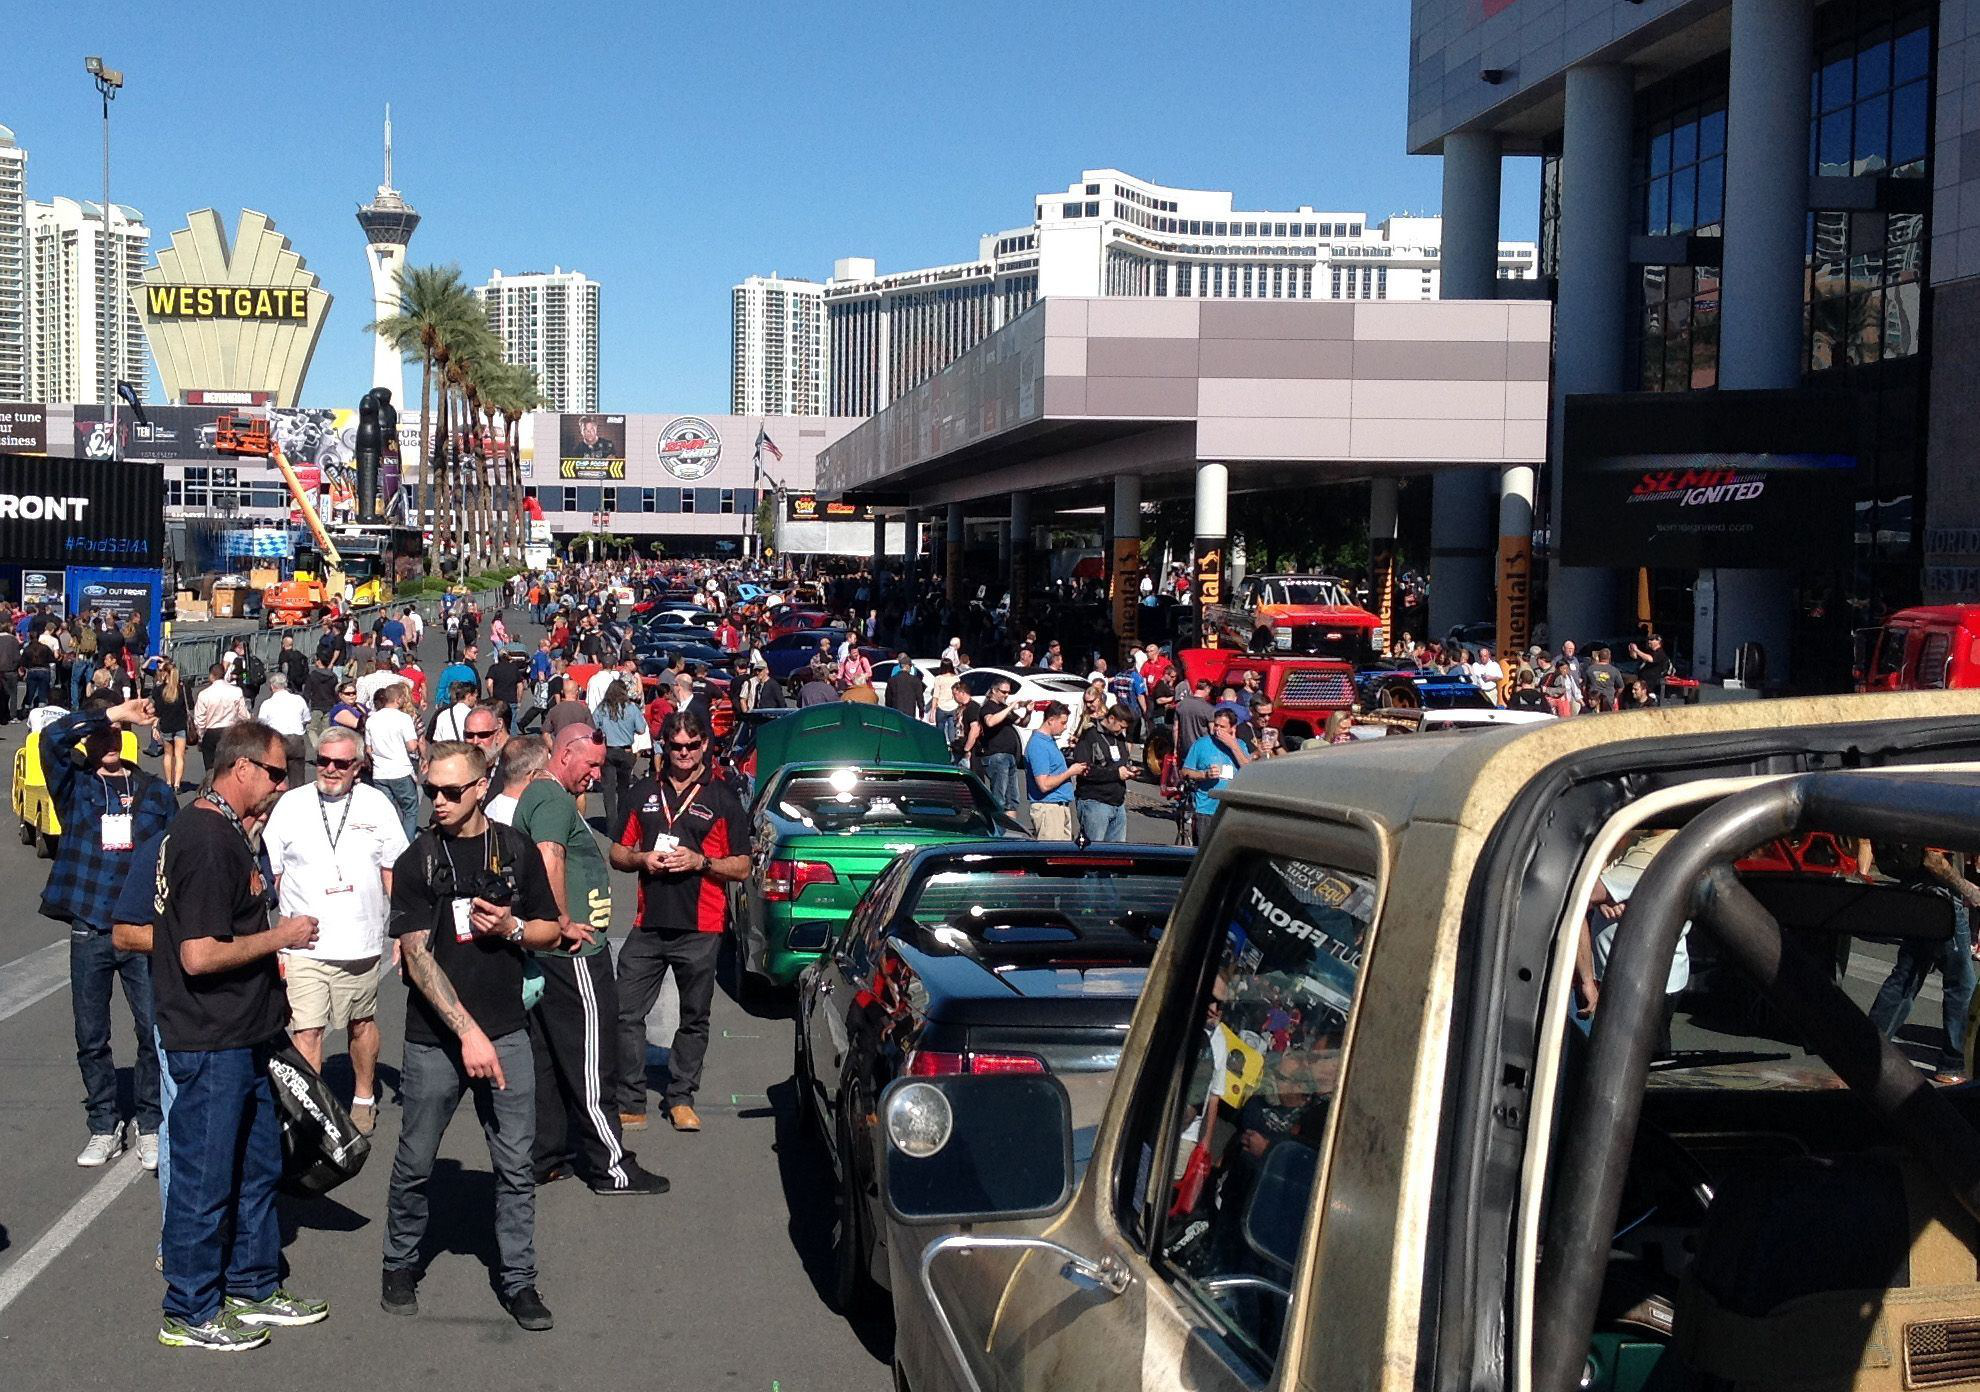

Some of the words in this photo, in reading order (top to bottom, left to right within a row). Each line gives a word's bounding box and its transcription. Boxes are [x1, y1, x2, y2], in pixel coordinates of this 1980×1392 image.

[149, 287, 305, 317] WESTGATE
[14, 412, 42, 422] tune
[1632, 467, 1736, 495] SEMA
[1680, 481, 1765, 507] IGNITED
[65, 536, 149, 553] #FordSEMA
